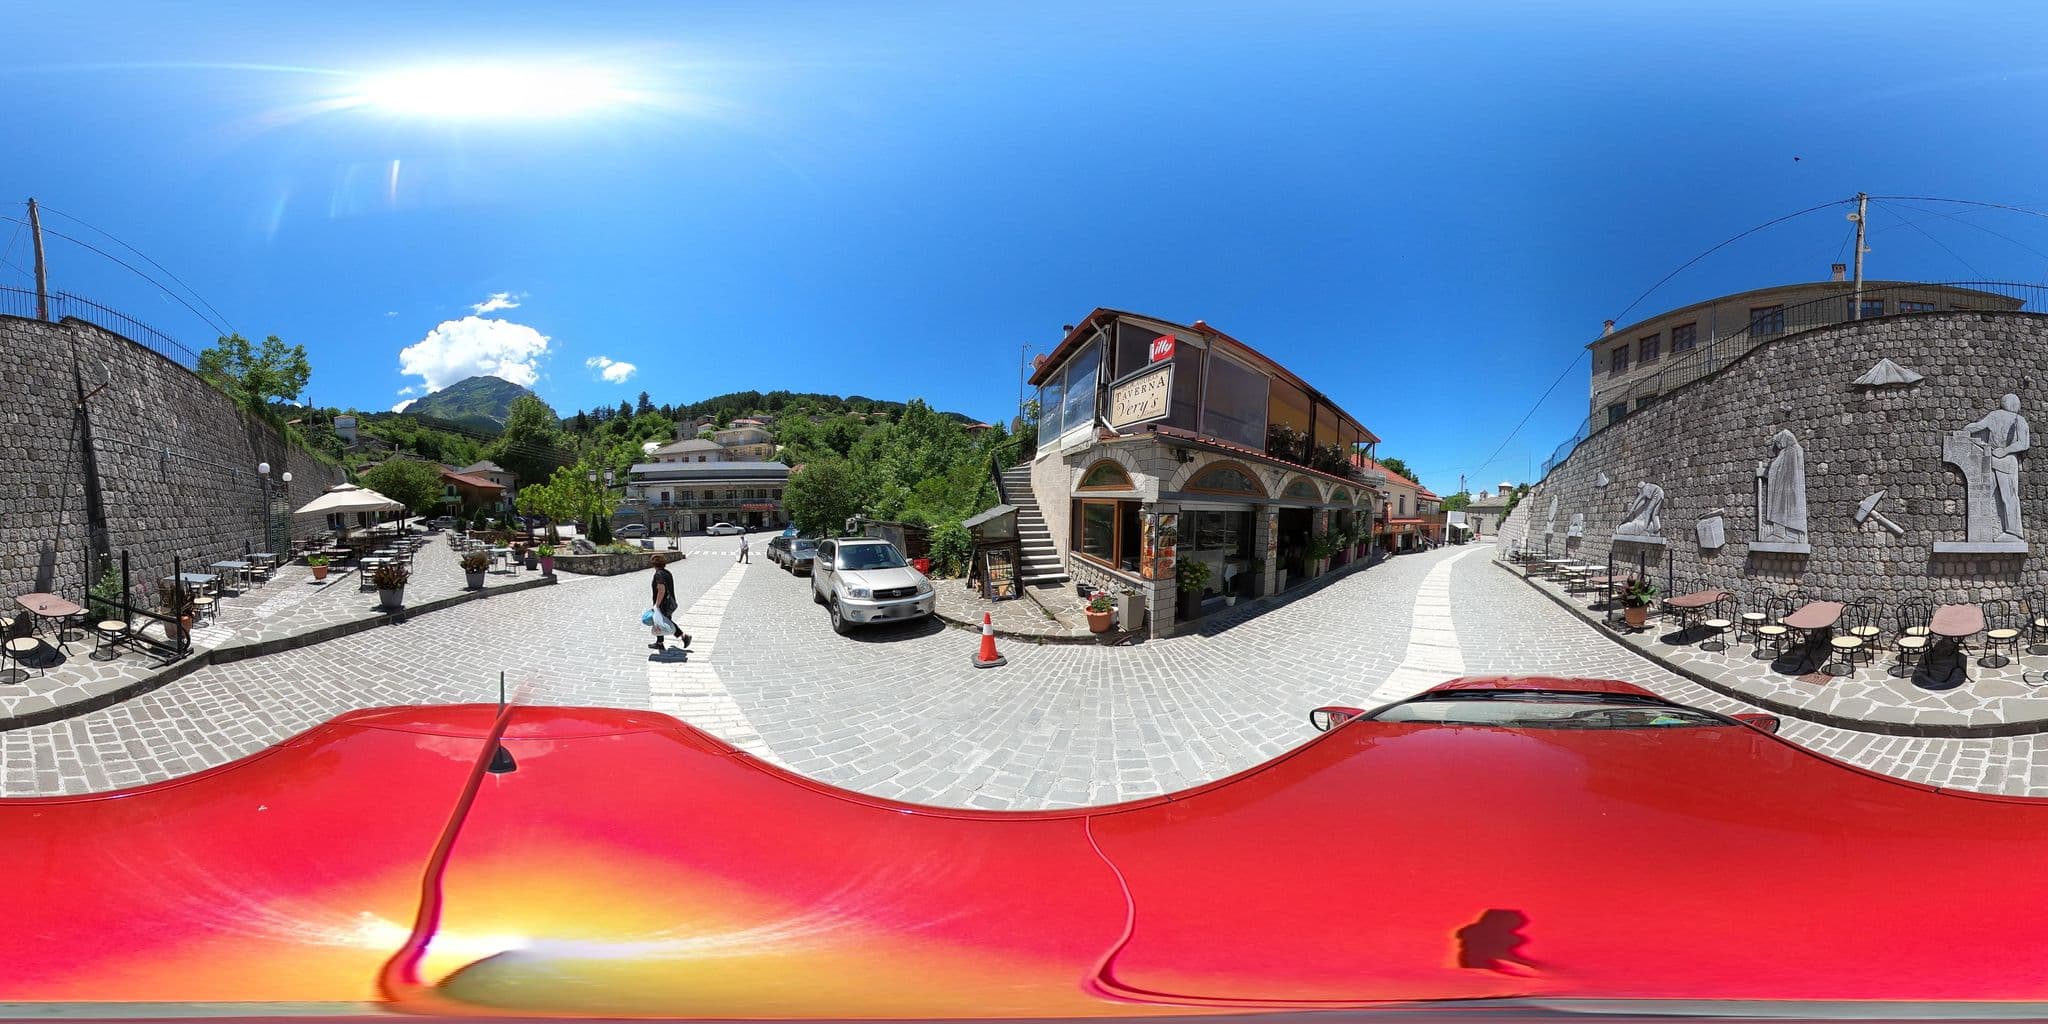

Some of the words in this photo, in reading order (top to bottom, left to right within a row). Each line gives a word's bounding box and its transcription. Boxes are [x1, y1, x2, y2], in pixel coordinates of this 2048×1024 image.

[1154, 339, 1172, 356] illy
[1116, 375, 1165, 403] TAVERNA
[1117, 393, 1159, 418] Very's
